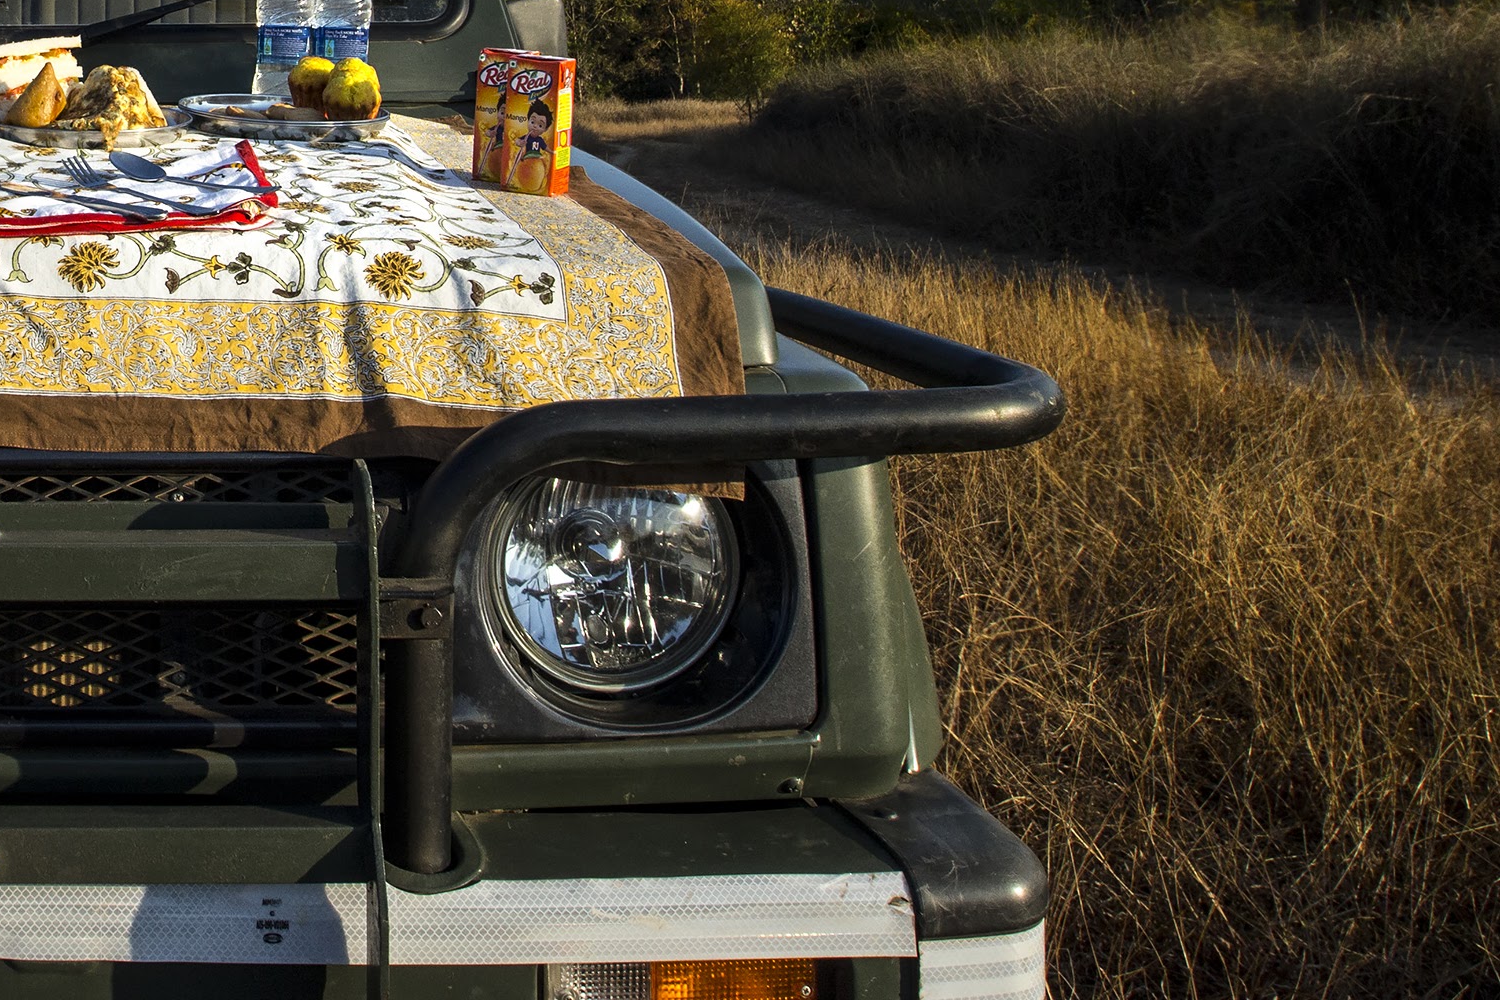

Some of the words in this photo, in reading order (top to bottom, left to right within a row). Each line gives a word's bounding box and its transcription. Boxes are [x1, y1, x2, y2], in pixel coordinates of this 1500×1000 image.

[515, 73, 550, 94] Real
[476, 105, 497, 115] Mango
[506, 113, 527, 123] Mango
